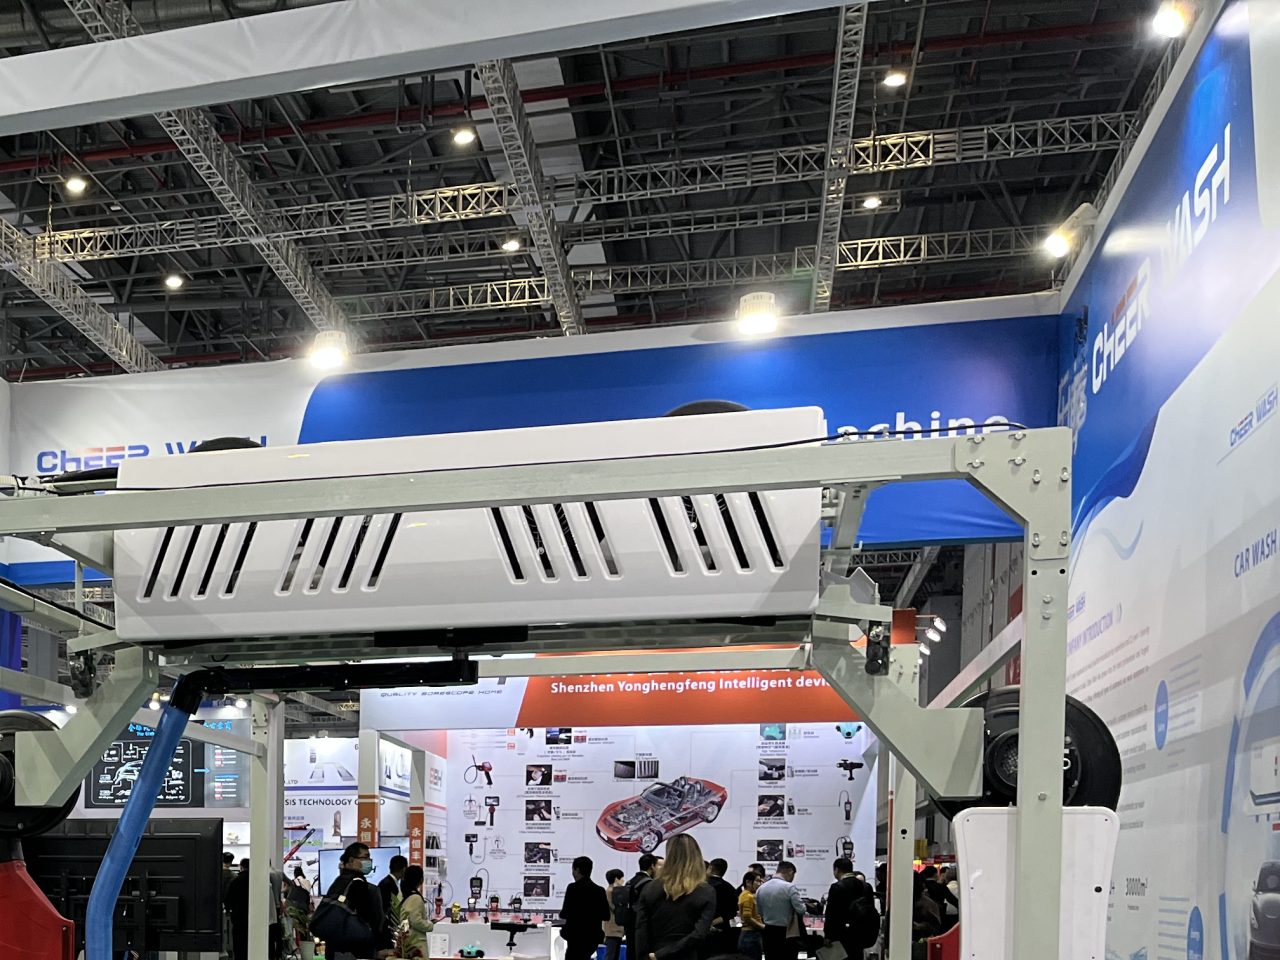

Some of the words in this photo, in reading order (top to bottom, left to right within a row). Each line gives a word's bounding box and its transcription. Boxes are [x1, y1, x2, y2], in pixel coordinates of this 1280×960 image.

[1160, 123, 1231, 291] WASH
[1234, 552, 1250, 578] CAR
[1252, 529, 1277, 566] WASH
[551, 681, 614, 693] Shenzhen
[618, 679, 716, 694] Yonghengfeng
[720, 676, 793, 691] Intelligent
[298, 798, 354, 806] TECHNOLOGY
